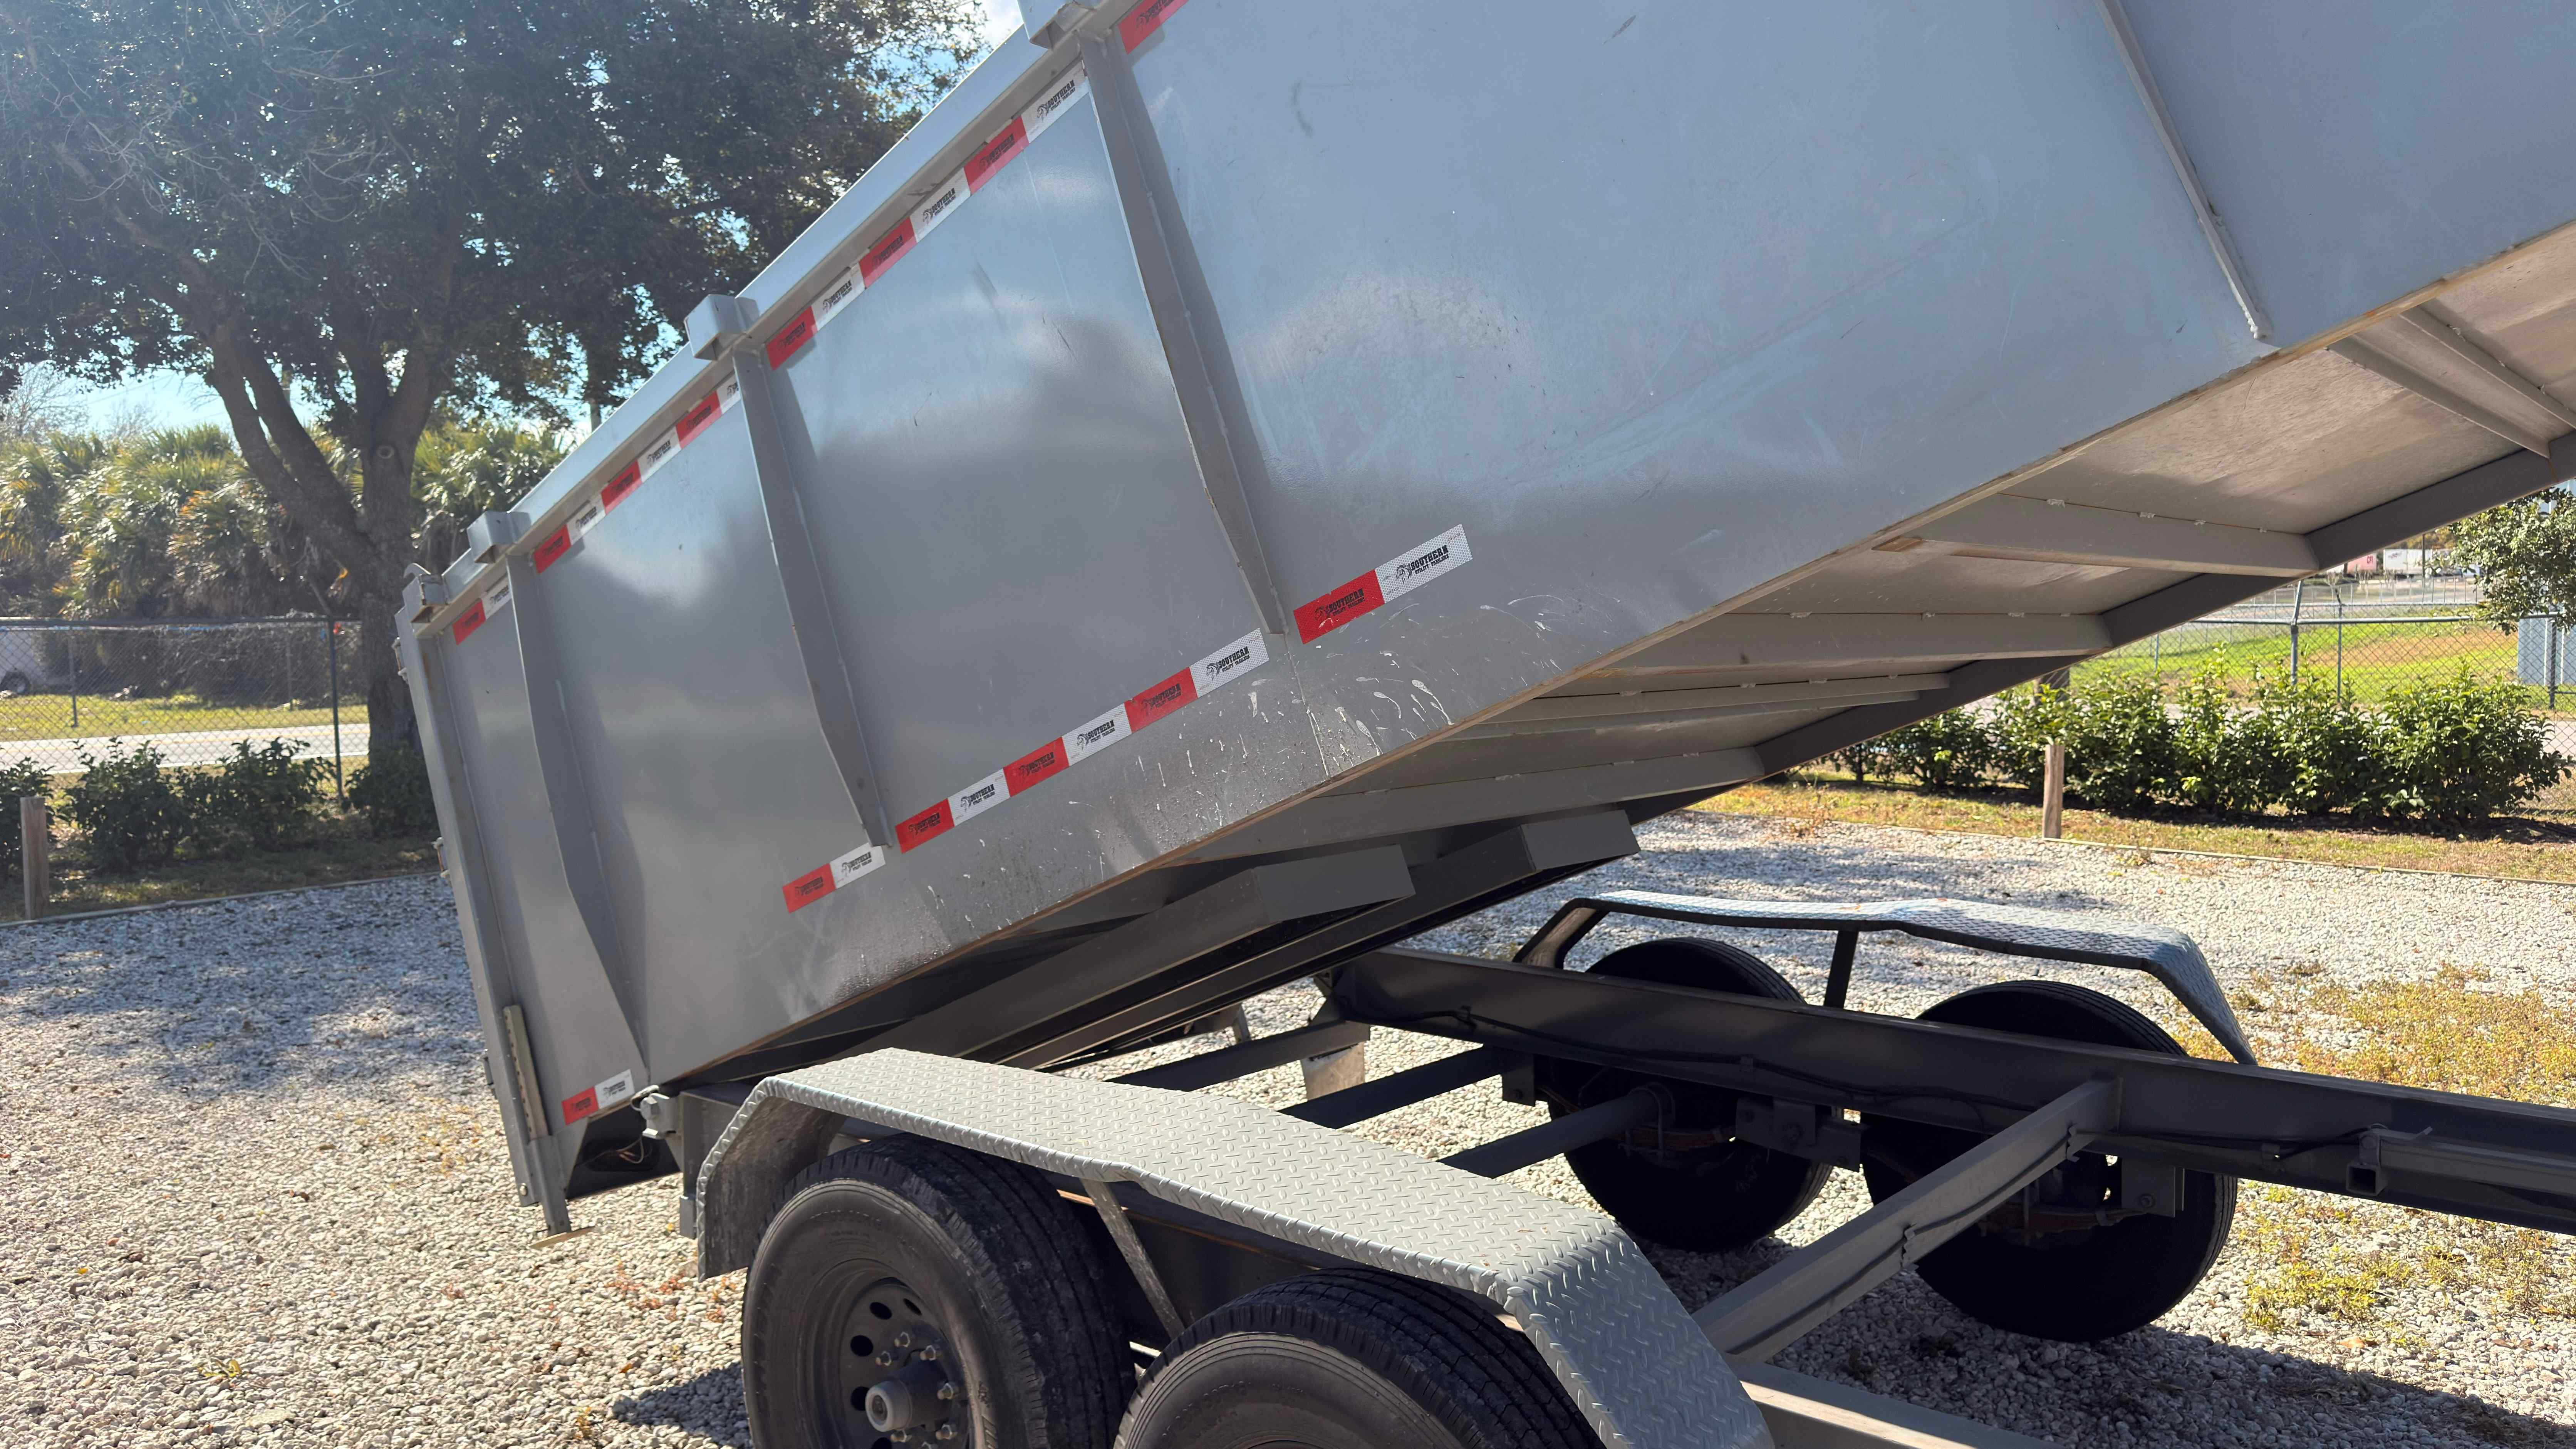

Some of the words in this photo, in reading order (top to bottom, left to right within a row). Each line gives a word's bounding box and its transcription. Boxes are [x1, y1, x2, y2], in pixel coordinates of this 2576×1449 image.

[1047, 80, 1075, 108] SOUTHERN
[932, 188, 955, 212] SOUTHERN
[1410, 545, 1449, 571] SOUTHERN
[1415, 564, 1429, 575] UTILITY
[1431, 553, 1449, 566] TRAILERS
[1328, 588, 1364, 611] SOUTHERN
[1218, 646, 1249, 669] SOUTHERN
[1222, 664, 1234, 672] UTILITY
[1234, 654, 1250, 666] TRAILERS
[1088, 719, 1115, 740] SOUTHERN
[970, 783, 995, 802] SOUTHERN
